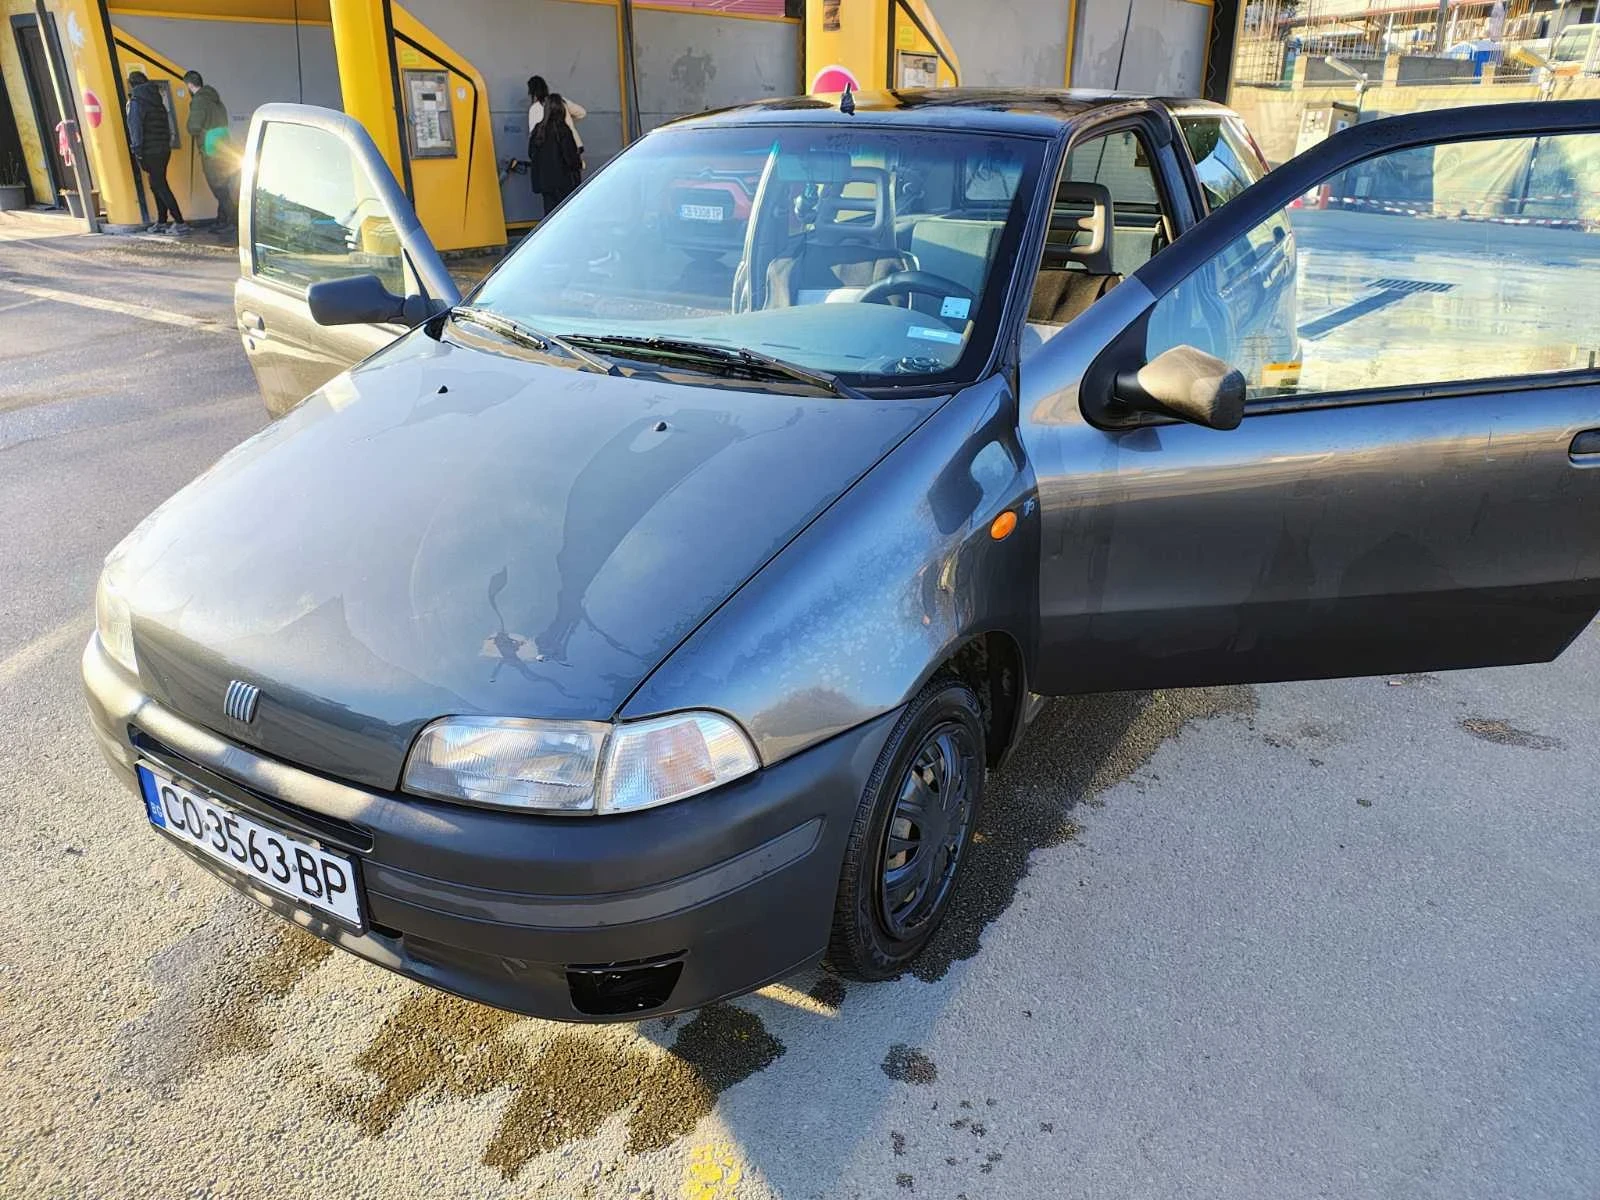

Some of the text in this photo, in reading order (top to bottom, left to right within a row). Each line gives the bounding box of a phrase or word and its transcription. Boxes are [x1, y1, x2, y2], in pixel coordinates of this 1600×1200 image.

[150, 801, 163, 818] BG
[161, 786, 347, 905] CO 3563 BP
